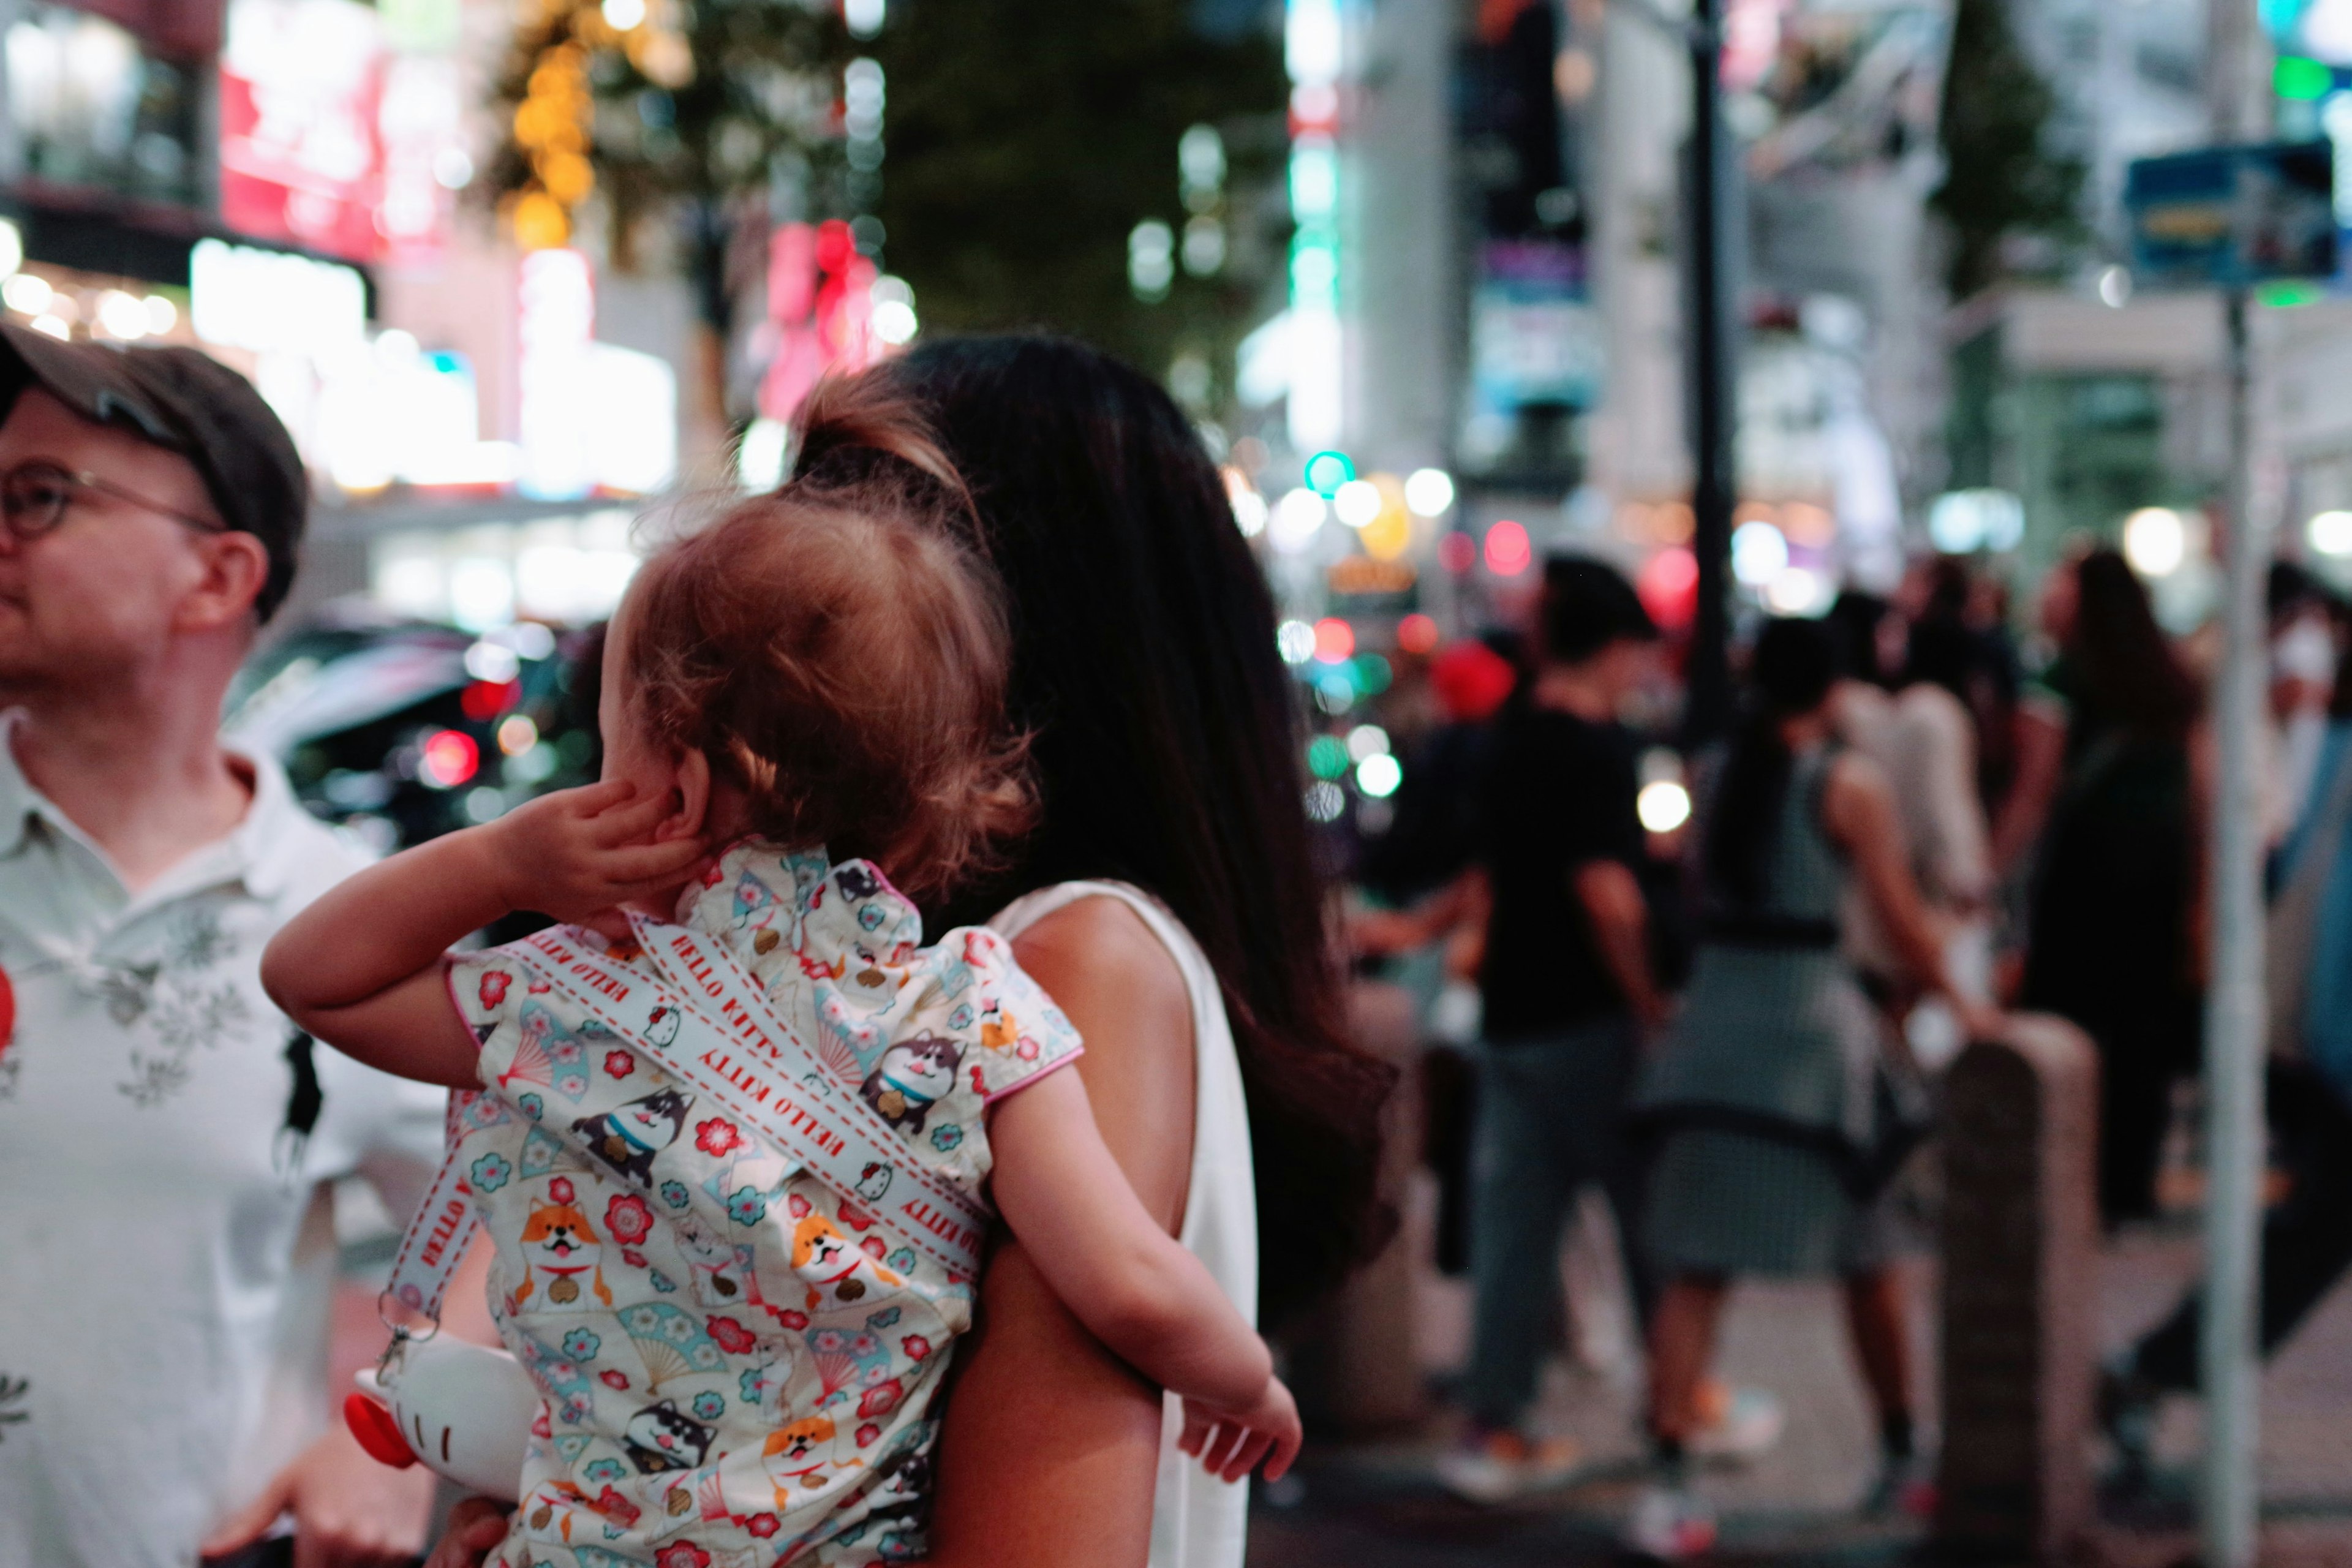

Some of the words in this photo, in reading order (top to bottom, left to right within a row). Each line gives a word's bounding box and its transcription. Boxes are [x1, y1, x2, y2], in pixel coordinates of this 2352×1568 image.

[522, 934, 575, 965] KITT
[670, 935, 724, 997] HELLO
[570, 963, 630, 1003] HELLO
[698, 1048, 771, 1103] KITTY
[775, 1098, 846, 1157] HELLO
[421, 1200, 466, 1267] HELLO
[900, 1199, 960, 1242] KITTY
